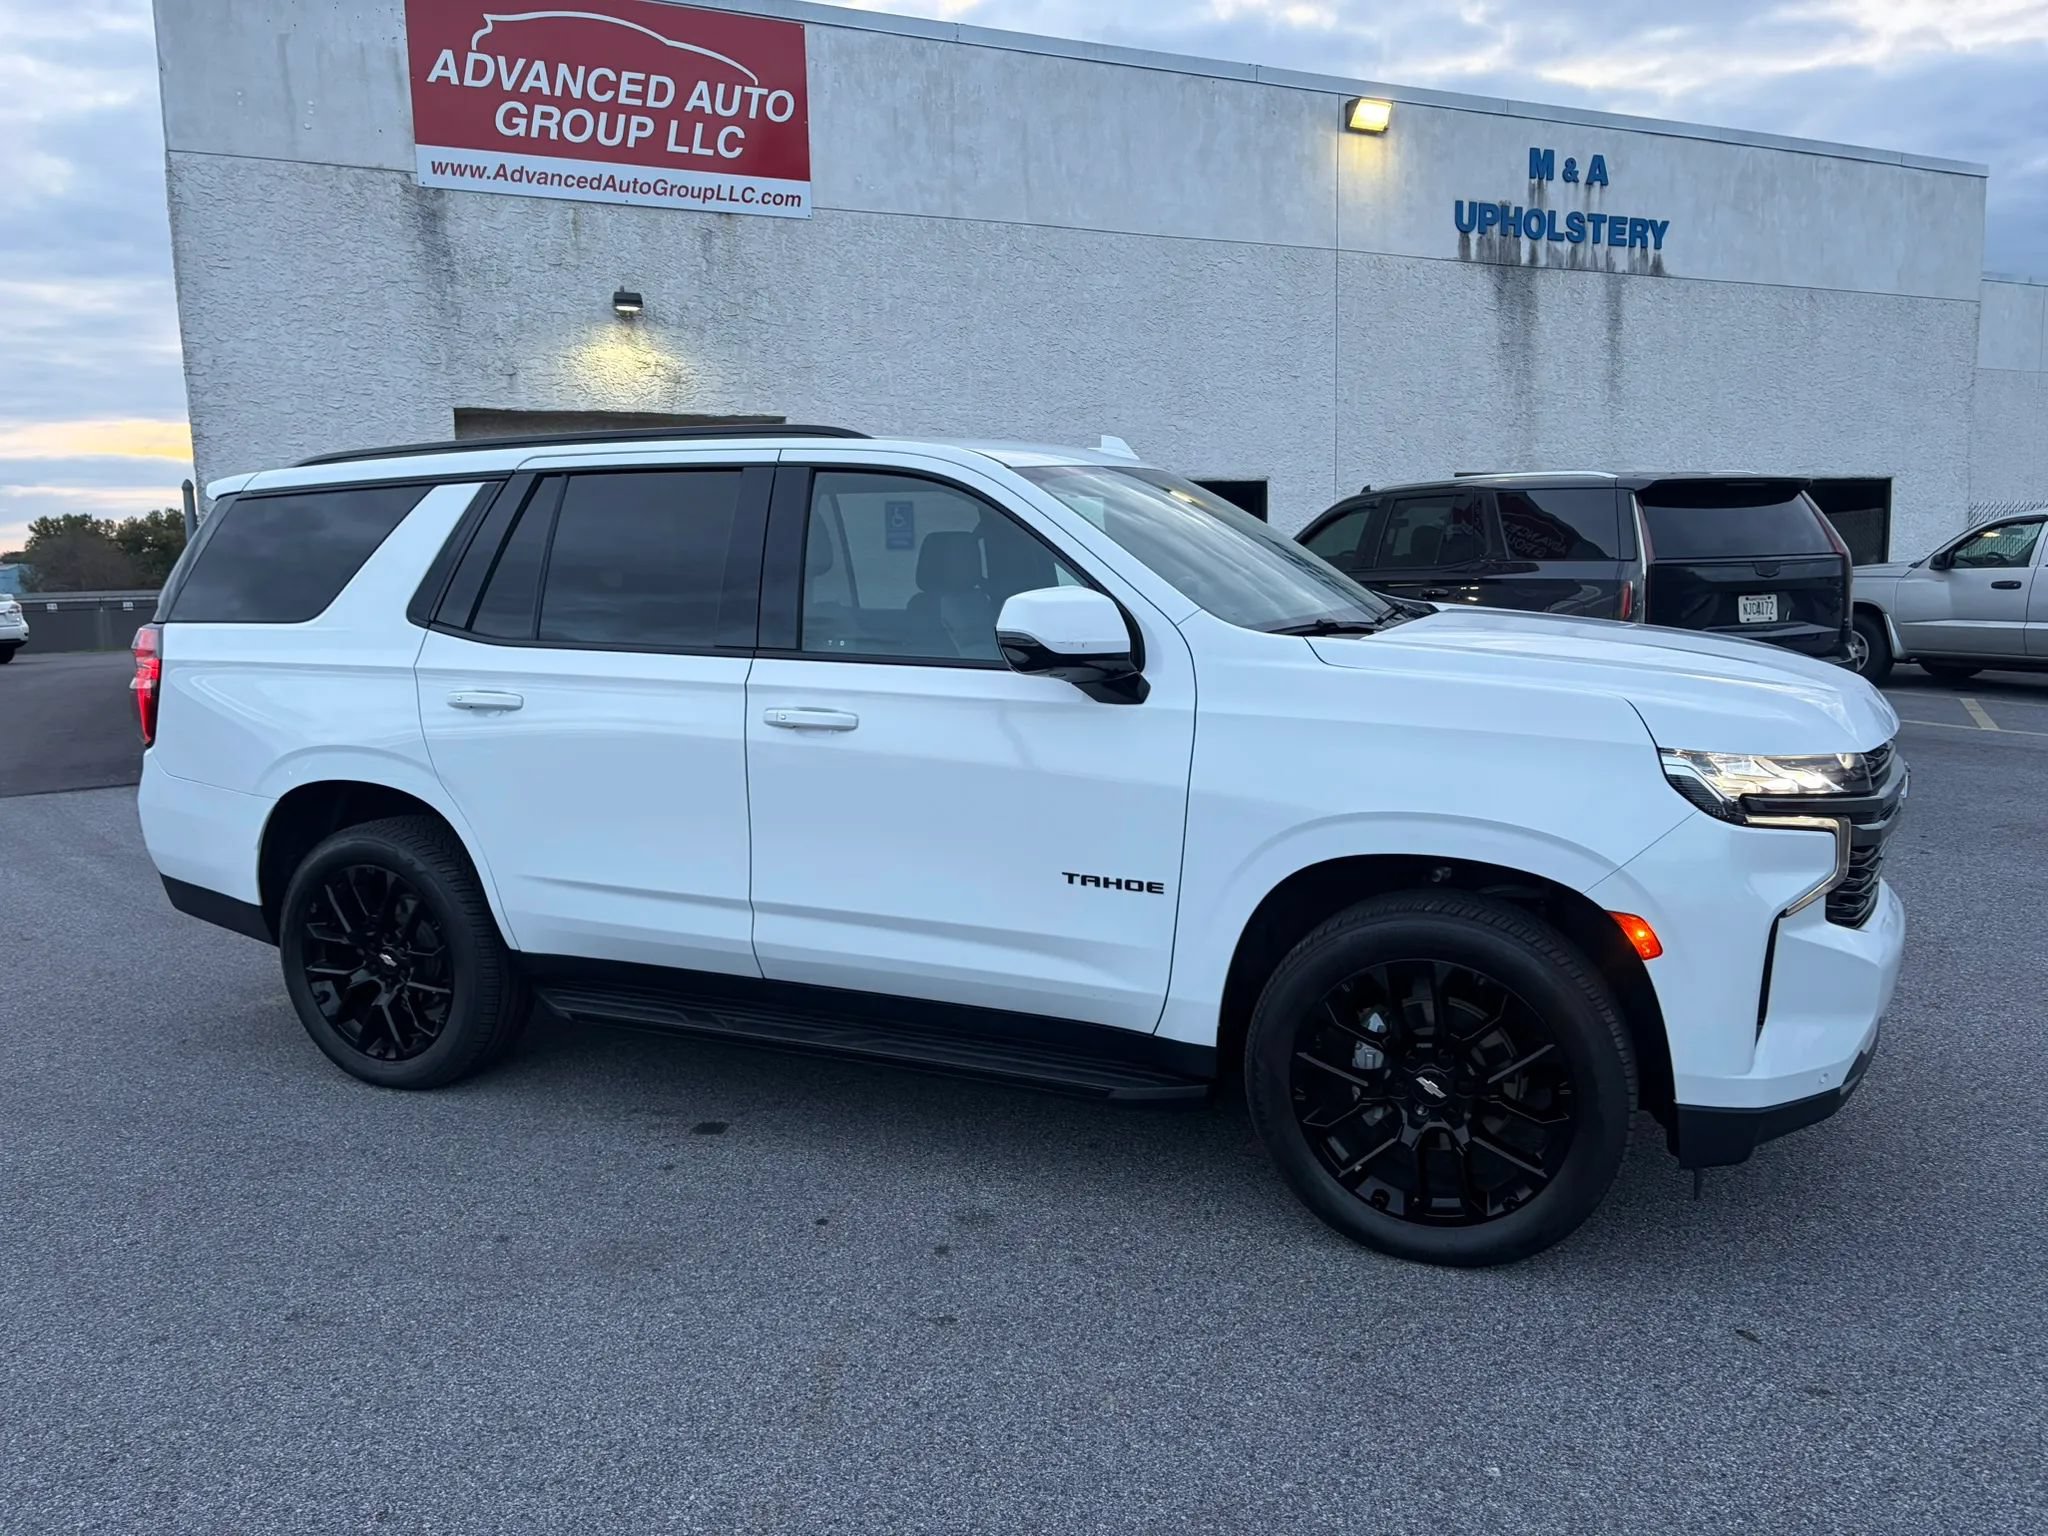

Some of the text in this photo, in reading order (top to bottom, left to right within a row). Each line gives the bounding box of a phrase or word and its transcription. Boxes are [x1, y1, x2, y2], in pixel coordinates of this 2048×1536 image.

[427, 49, 796, 123] ADVANCED AUTO
[495, 101, 746, 159] GROUP LLC
[431, 160, 802, 208] www.AdvancedAutoGroupLLC.com
[1529, 147, 1609, 186] M & A
[1454, 200, 1670, 250] UPHOLSTERY
[1061, 871, 1165, 894] TAHOE
